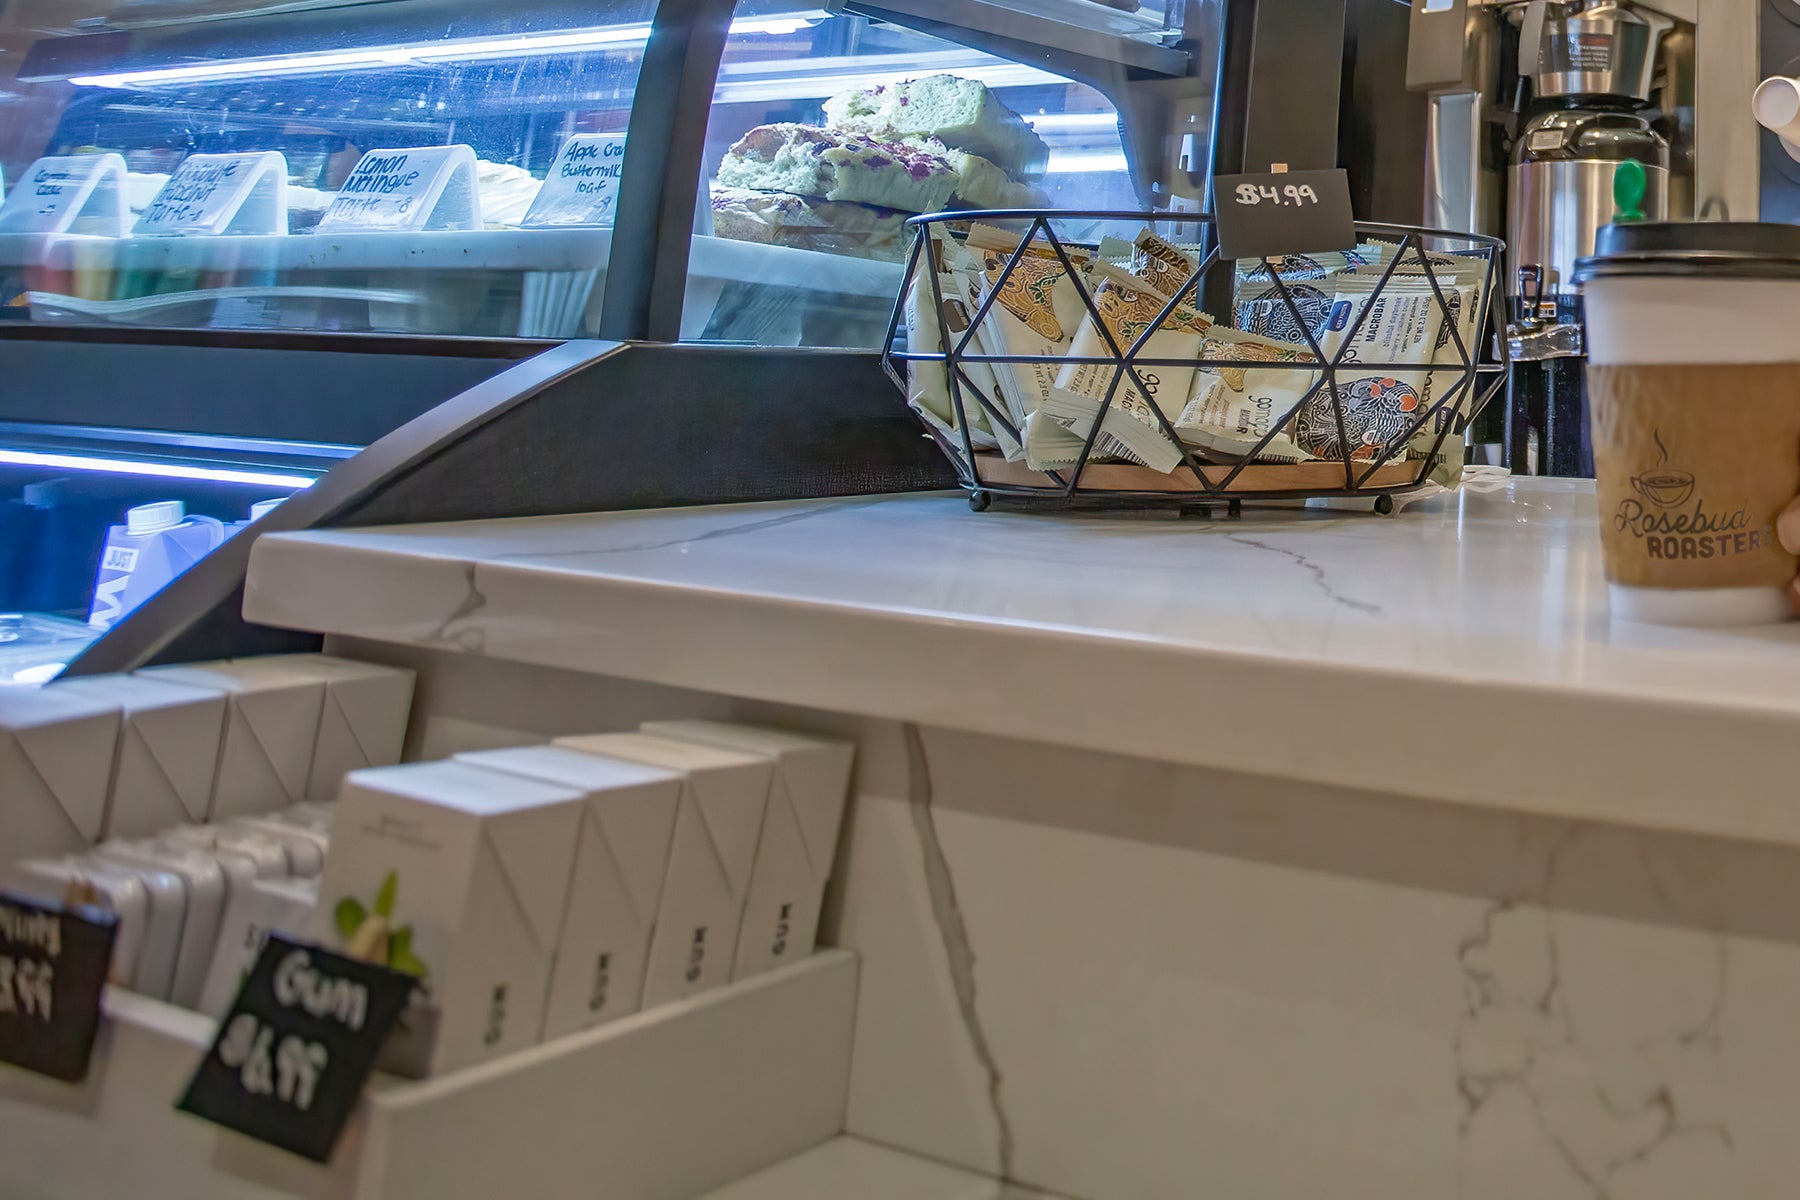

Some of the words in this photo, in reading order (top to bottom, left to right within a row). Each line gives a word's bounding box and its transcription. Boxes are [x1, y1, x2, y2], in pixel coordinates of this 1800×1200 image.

[354, 154, 408, 175] Lemon
[1235, 183, 1318, 207] $4.99
[1365, 297, 1388, 343] MACROBAR
[1614, 495, 1753, 538] Rosebud
[106, 550, 134, 569] JUST
[1646, 526, 1773, 560] ROASTERS
[272, 951, 369, 1031] Gum
